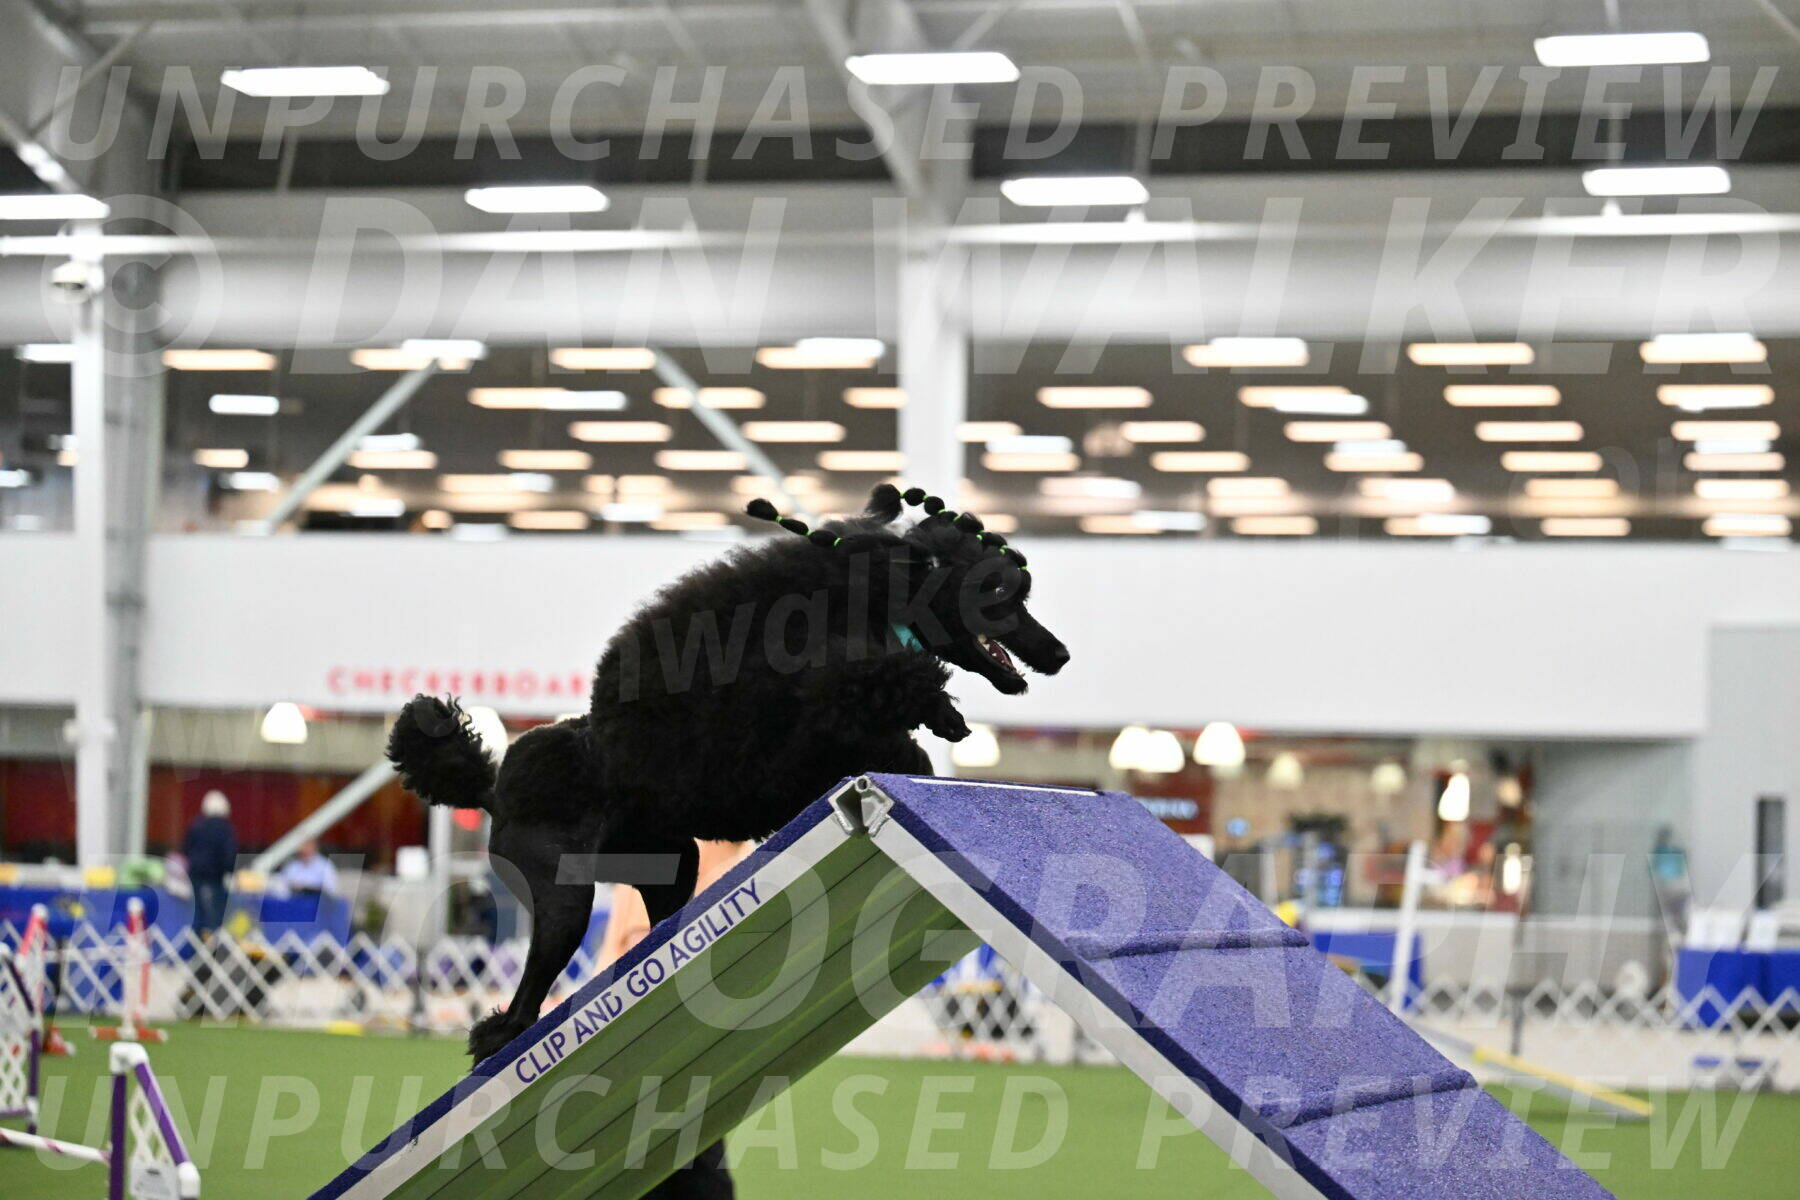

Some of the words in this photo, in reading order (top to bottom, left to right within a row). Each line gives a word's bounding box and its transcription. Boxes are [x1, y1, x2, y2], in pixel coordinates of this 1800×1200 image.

[326, 664, 592, 698] CHECKERBOAR
[515, 1031, 566, 1084] CLIP
[573, 991, 623, 1045] AND
[626, 958, 665, 998] GO
[669, 878, 762, 970] AGILITY
